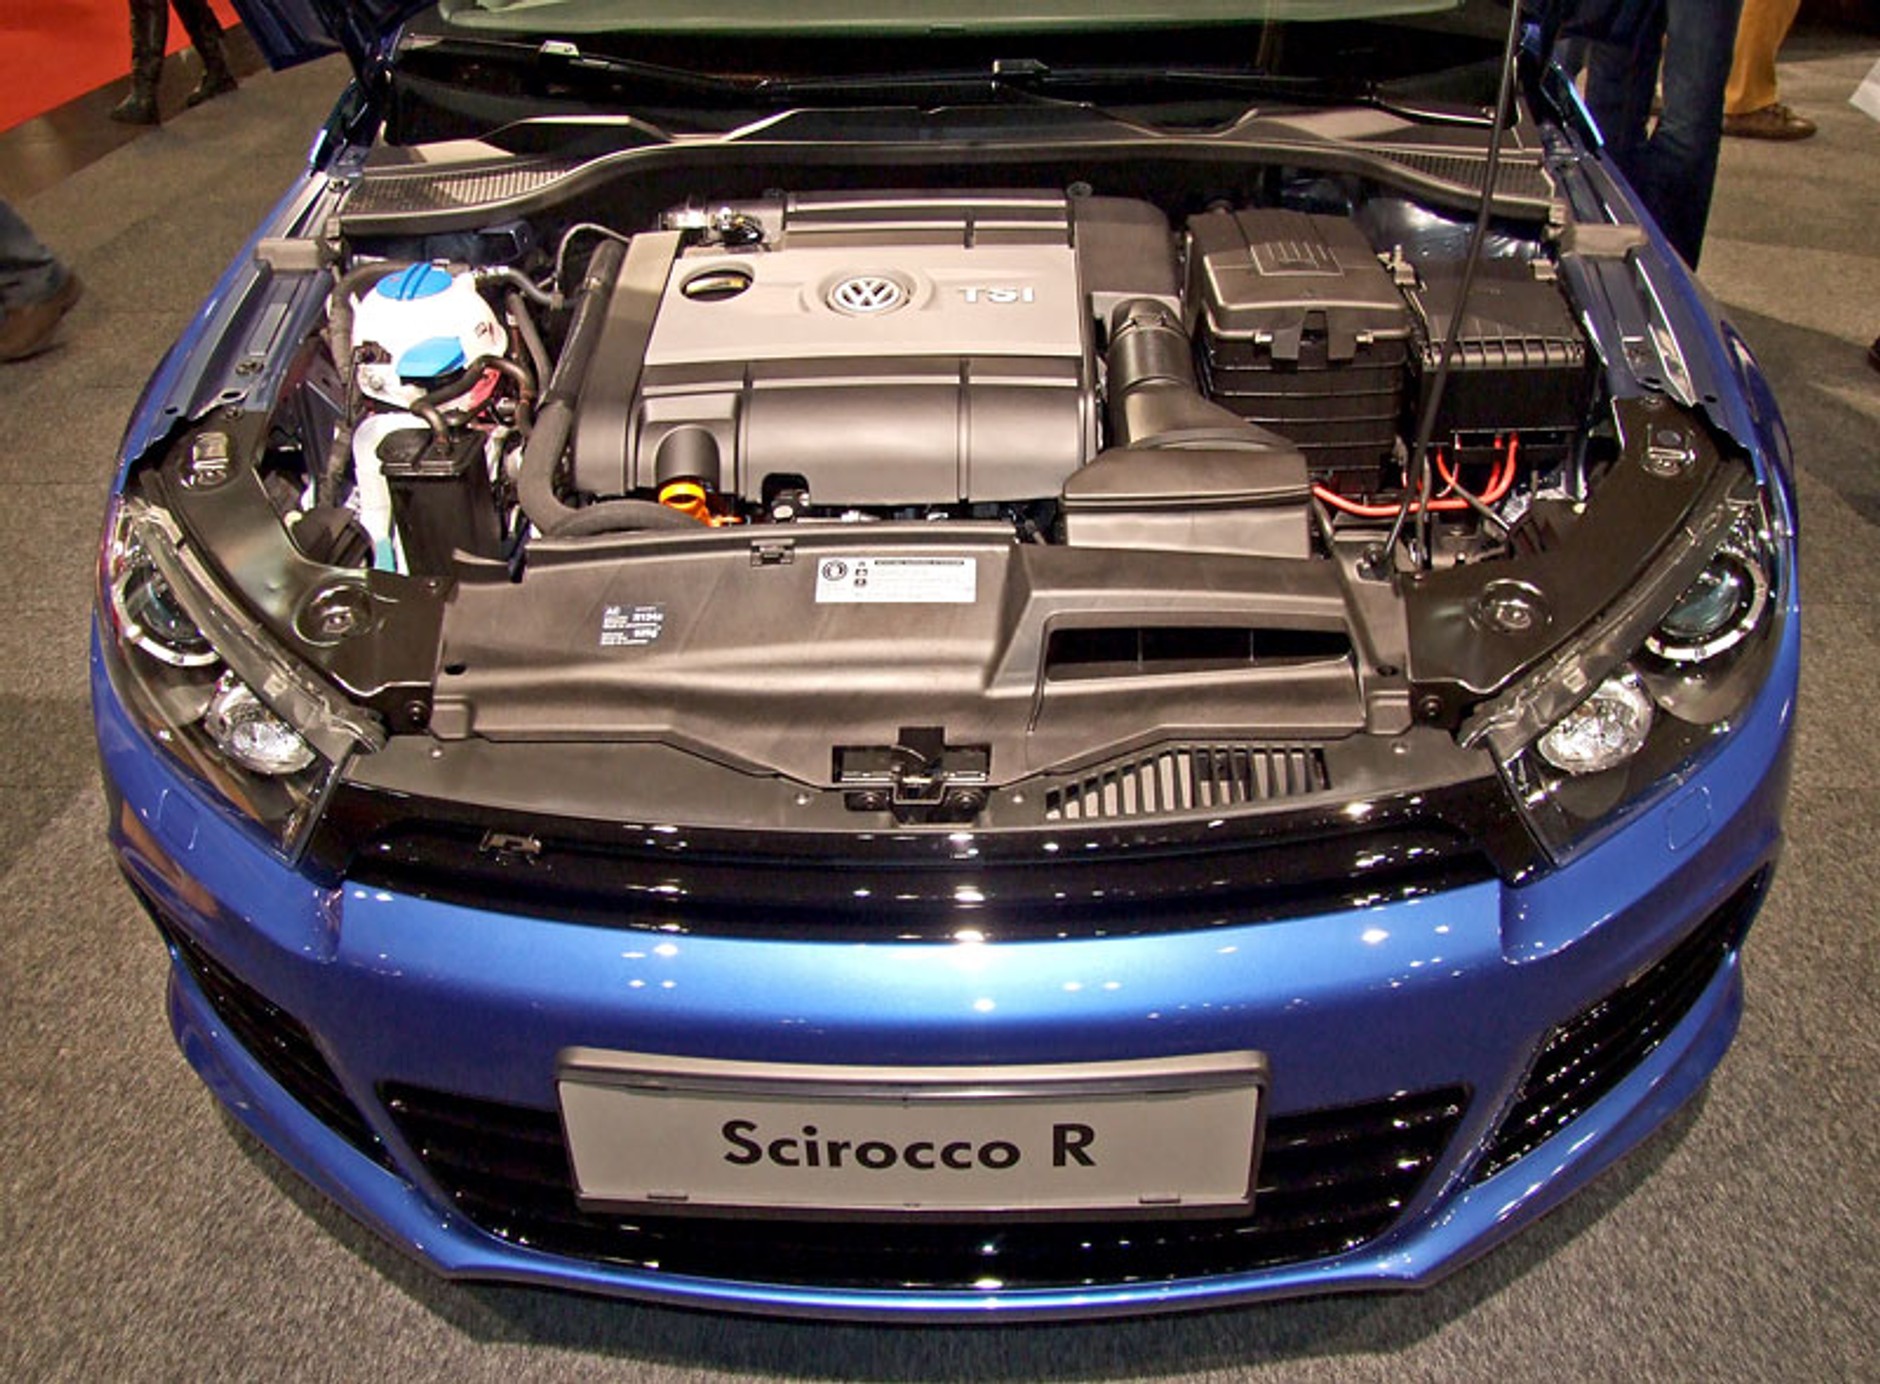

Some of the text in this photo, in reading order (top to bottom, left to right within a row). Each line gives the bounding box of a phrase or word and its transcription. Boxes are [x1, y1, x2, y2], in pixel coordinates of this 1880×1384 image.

[958, 286, 1035, 303] TSI
[721, 1119, 1097, 1170] Scirocco R
